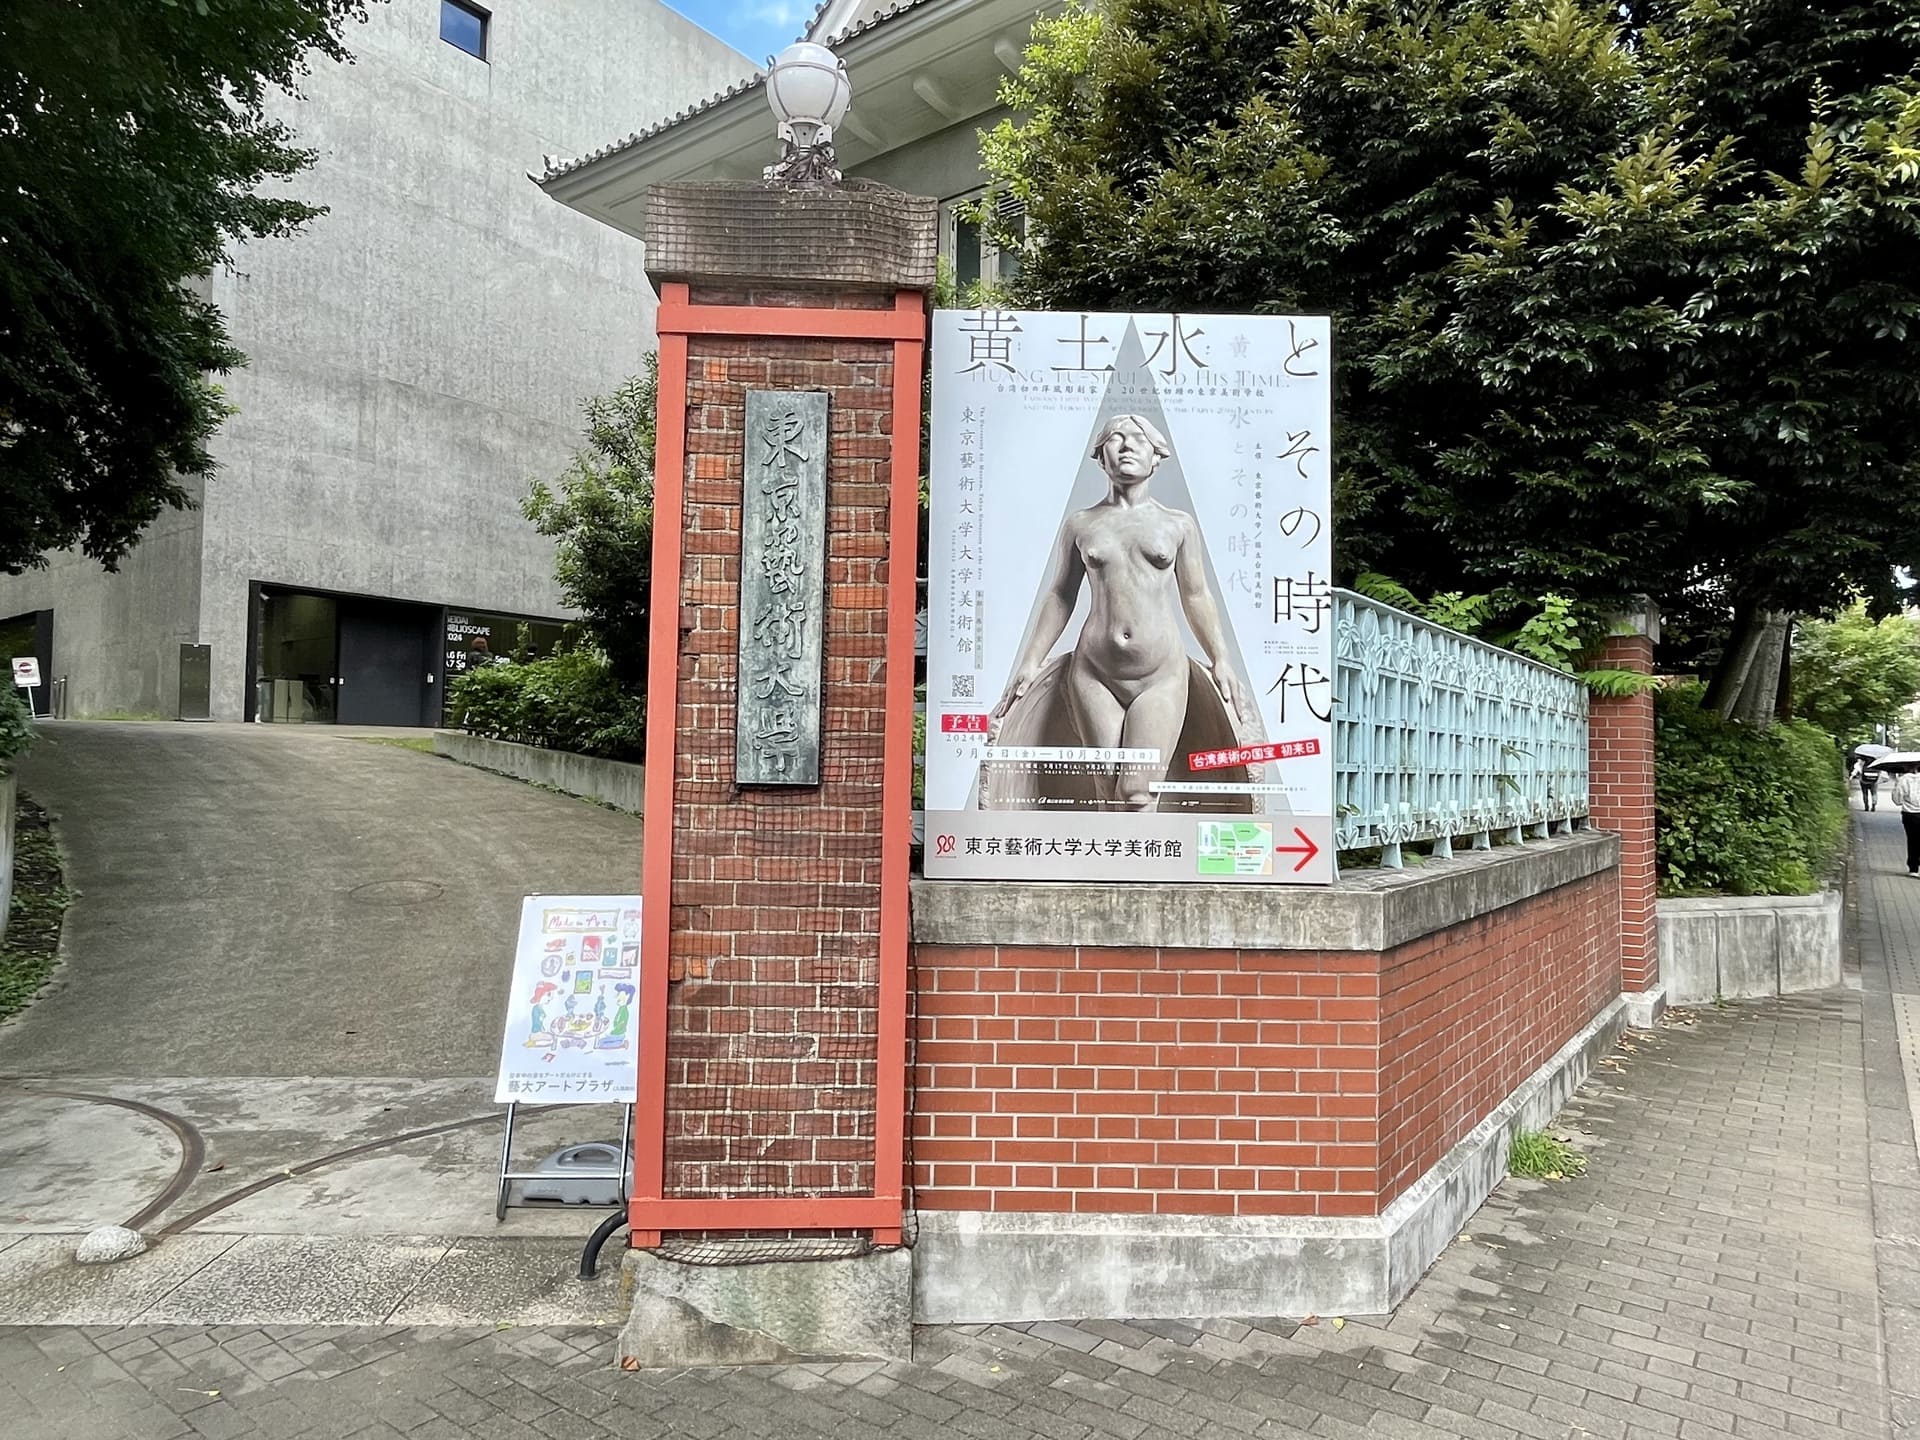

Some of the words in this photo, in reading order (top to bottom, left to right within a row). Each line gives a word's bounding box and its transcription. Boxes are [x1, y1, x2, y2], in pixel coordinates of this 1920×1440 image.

[956, 406, 976, 655] 東京藝術大学大学美術館
[1266, 319, 1331, 724] とその時代
[447, 633, 463, 642] 024
[1193, 745, 1275, 768] 台湾美術の国宝
[1280, 741, 1315, 758] 初来日
[964, 836, 1183, 858] 東京藝術大学大学美術館
[508, 1080, 614, 1092] 藝大アートプラザ
